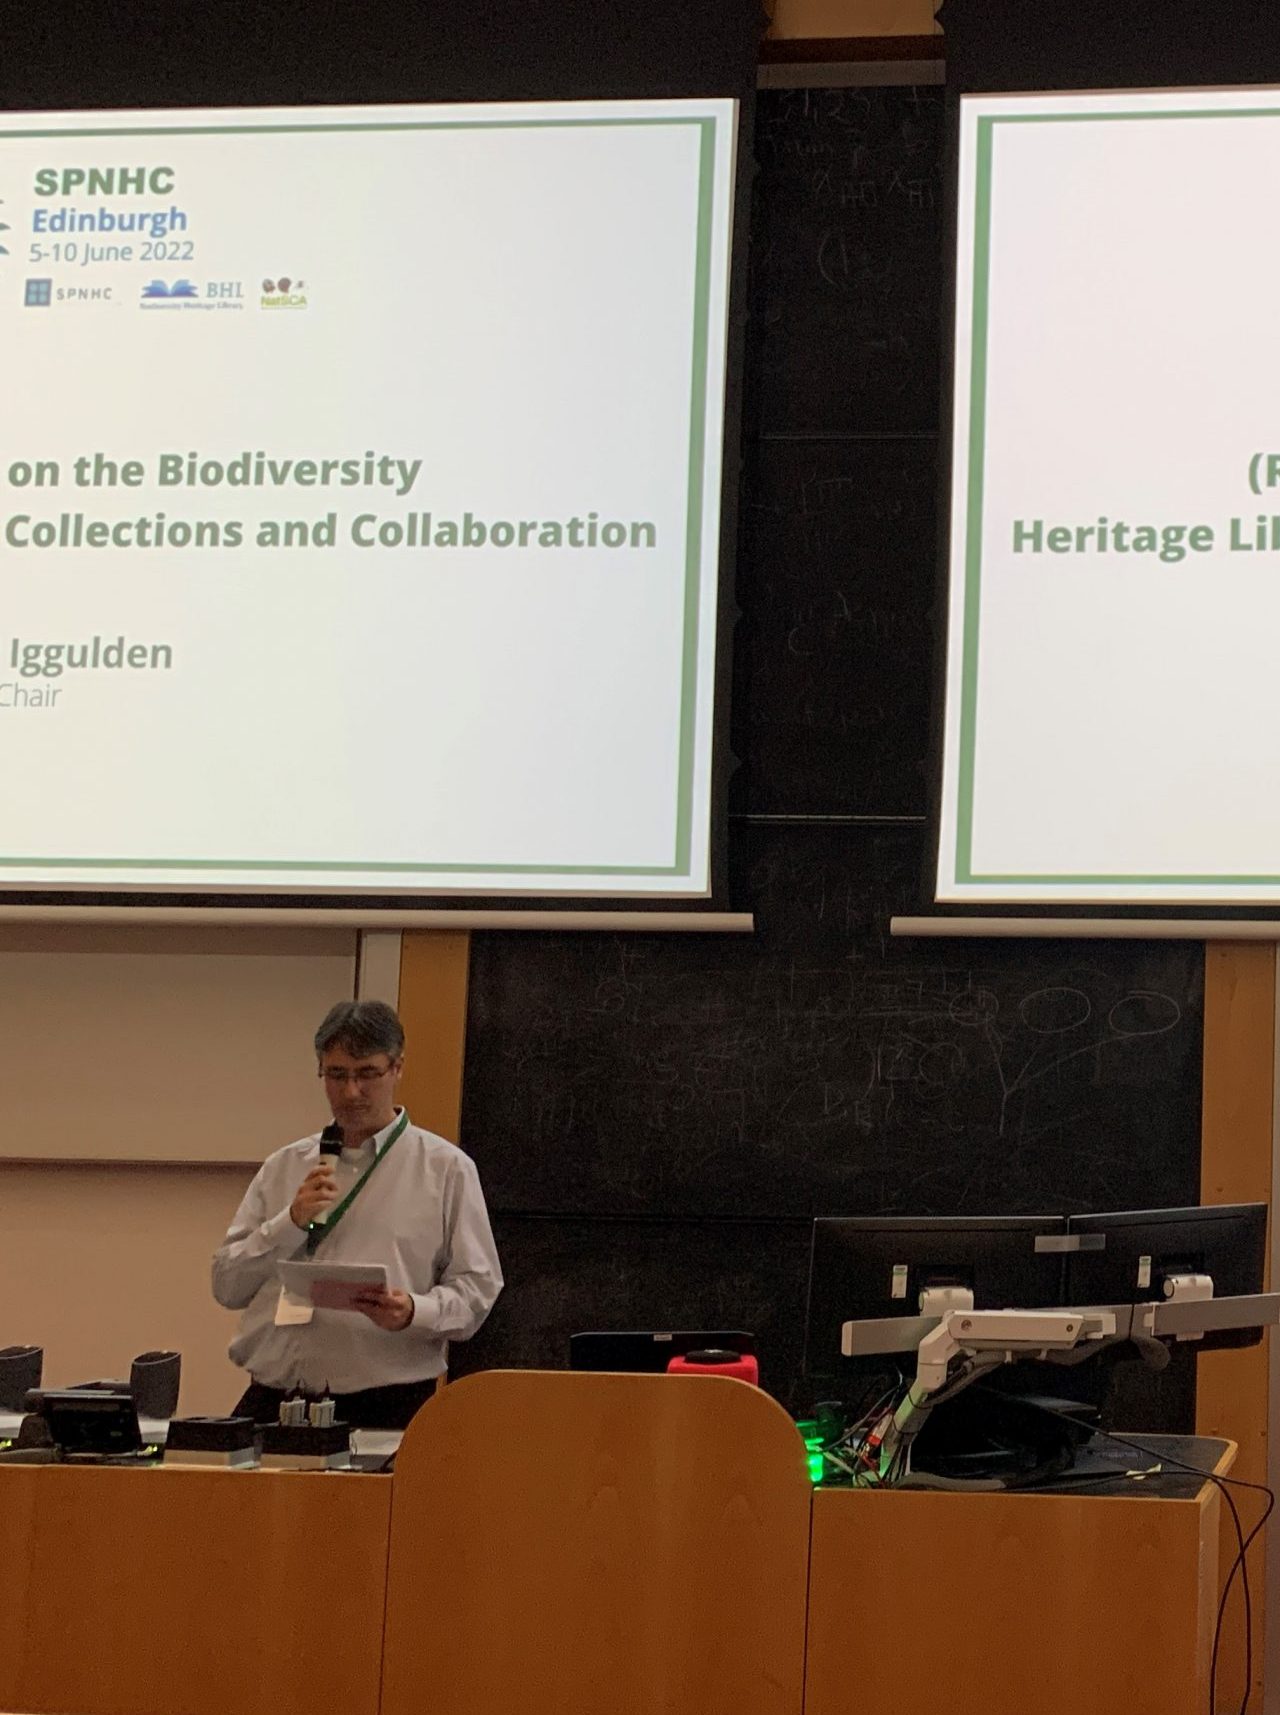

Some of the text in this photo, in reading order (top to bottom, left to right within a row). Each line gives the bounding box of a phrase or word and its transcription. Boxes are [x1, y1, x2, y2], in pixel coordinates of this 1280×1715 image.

[34, 167, 174, 196] SPNHC
[33, 206, 186, 237] Edinburgh
[29, 241, 194, 266] 5-10 June 2022
[57, 287, 112, 300] SPNHC
[206, 282, 244, 298] BHL
[8, 451, 422, 496] on the Biodiversity
[6, 512, 656, 548] Collections and Collaboration
[1013, 517, 1214, 563] Heritage
[11, 636, 172, 677] Iggulden
